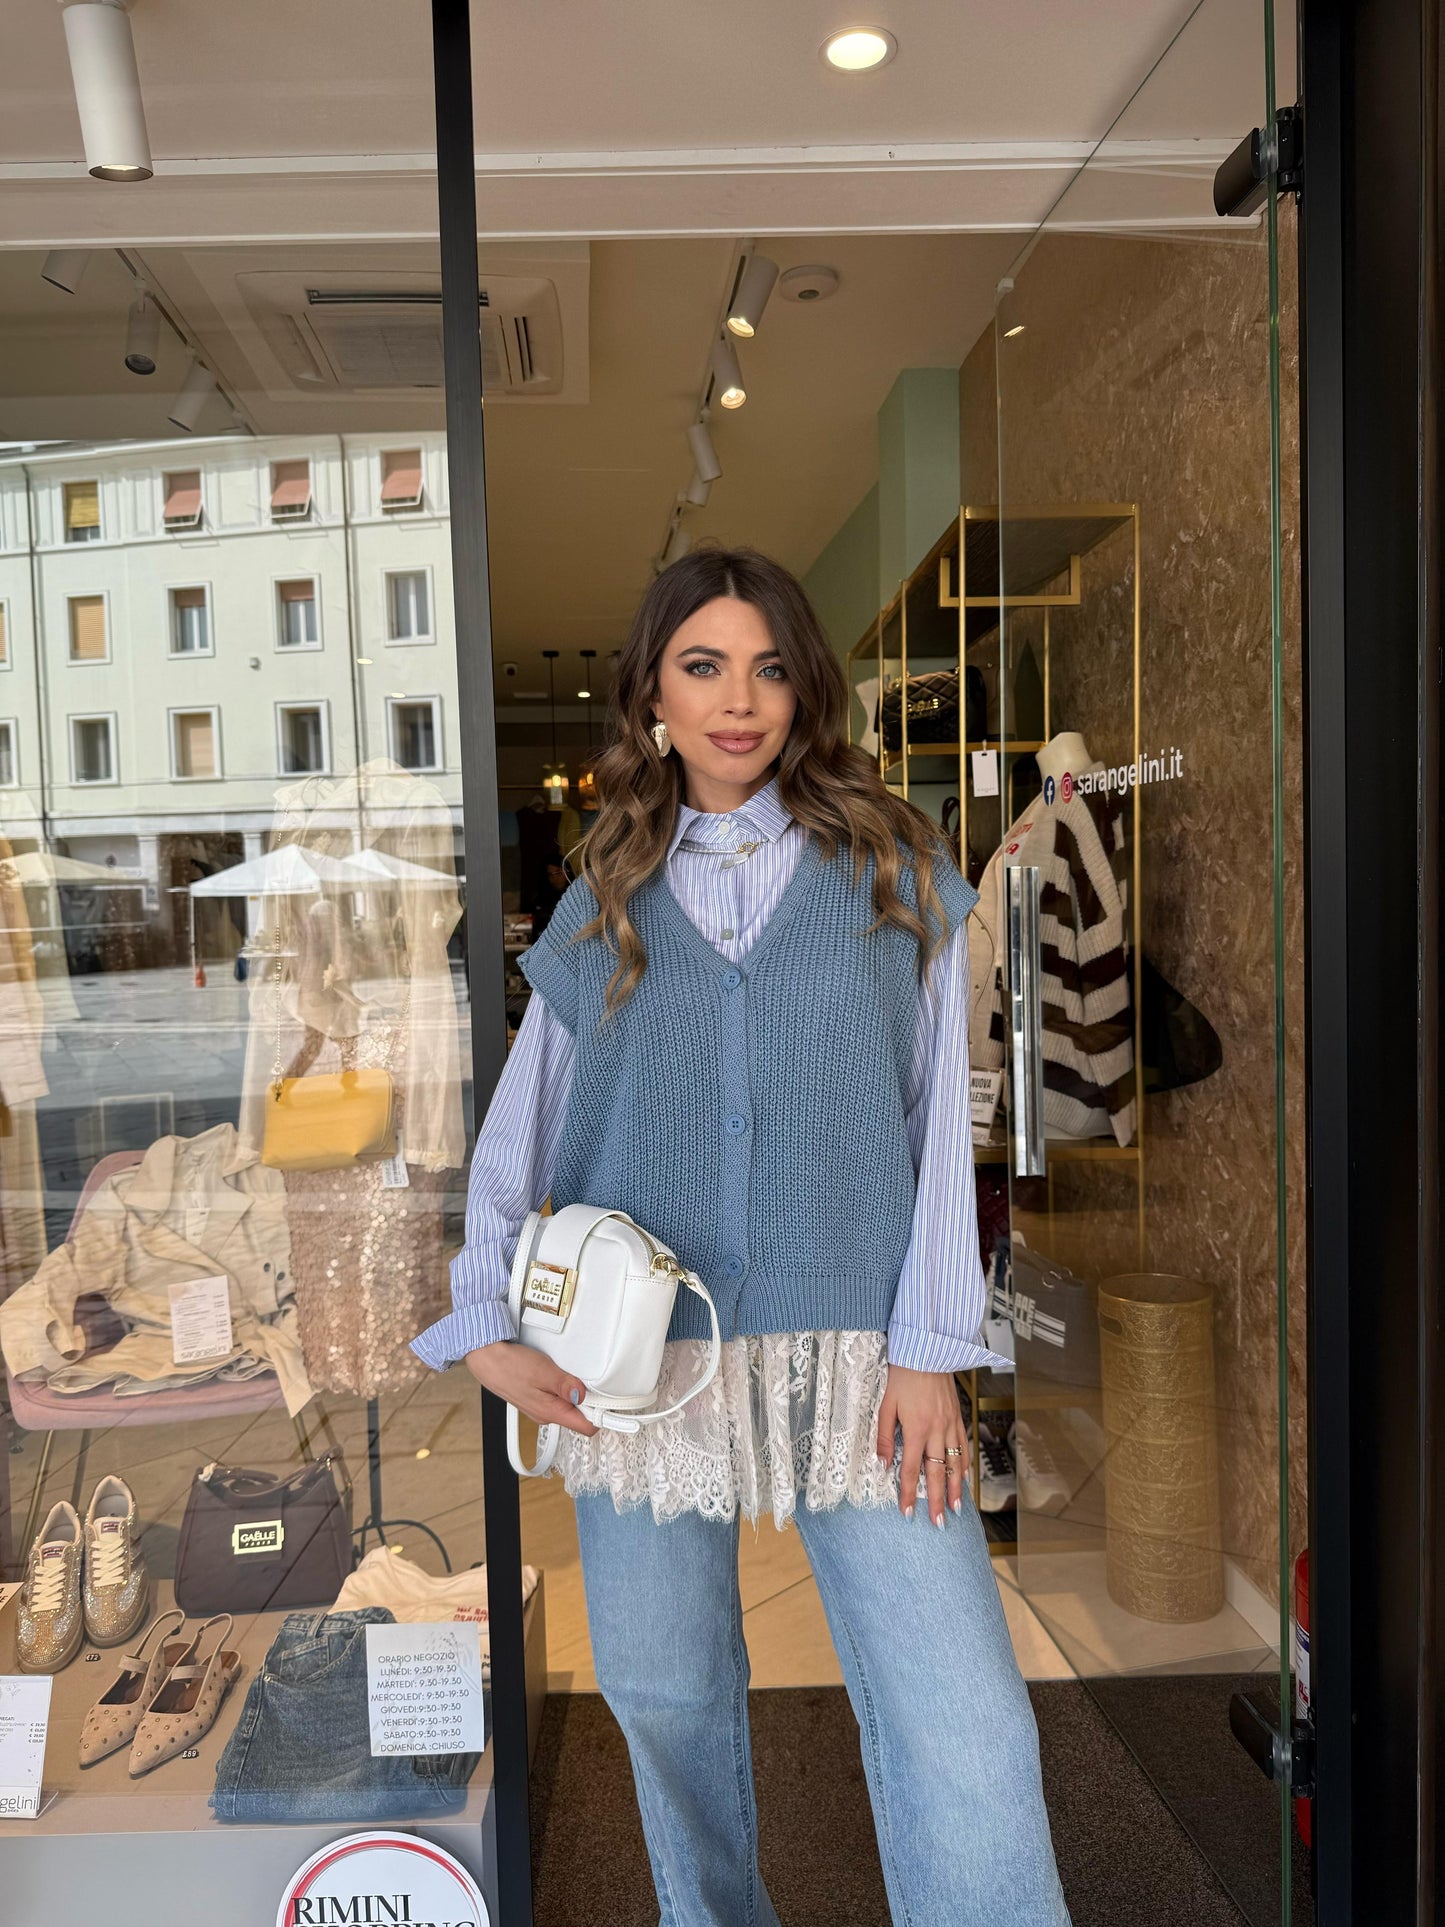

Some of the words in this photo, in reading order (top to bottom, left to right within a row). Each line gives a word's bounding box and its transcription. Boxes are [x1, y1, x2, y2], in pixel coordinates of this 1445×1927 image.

[1077, 746, 1184, 796] sarangelini.it
[378, 1655, 411, 1663] ORARIO
[413, 1652, 455, 1661] NEGOZIO
[380, 1743, 428, 1753] DOMENICA
[291, 1894, 412, 1924] RIMINI
